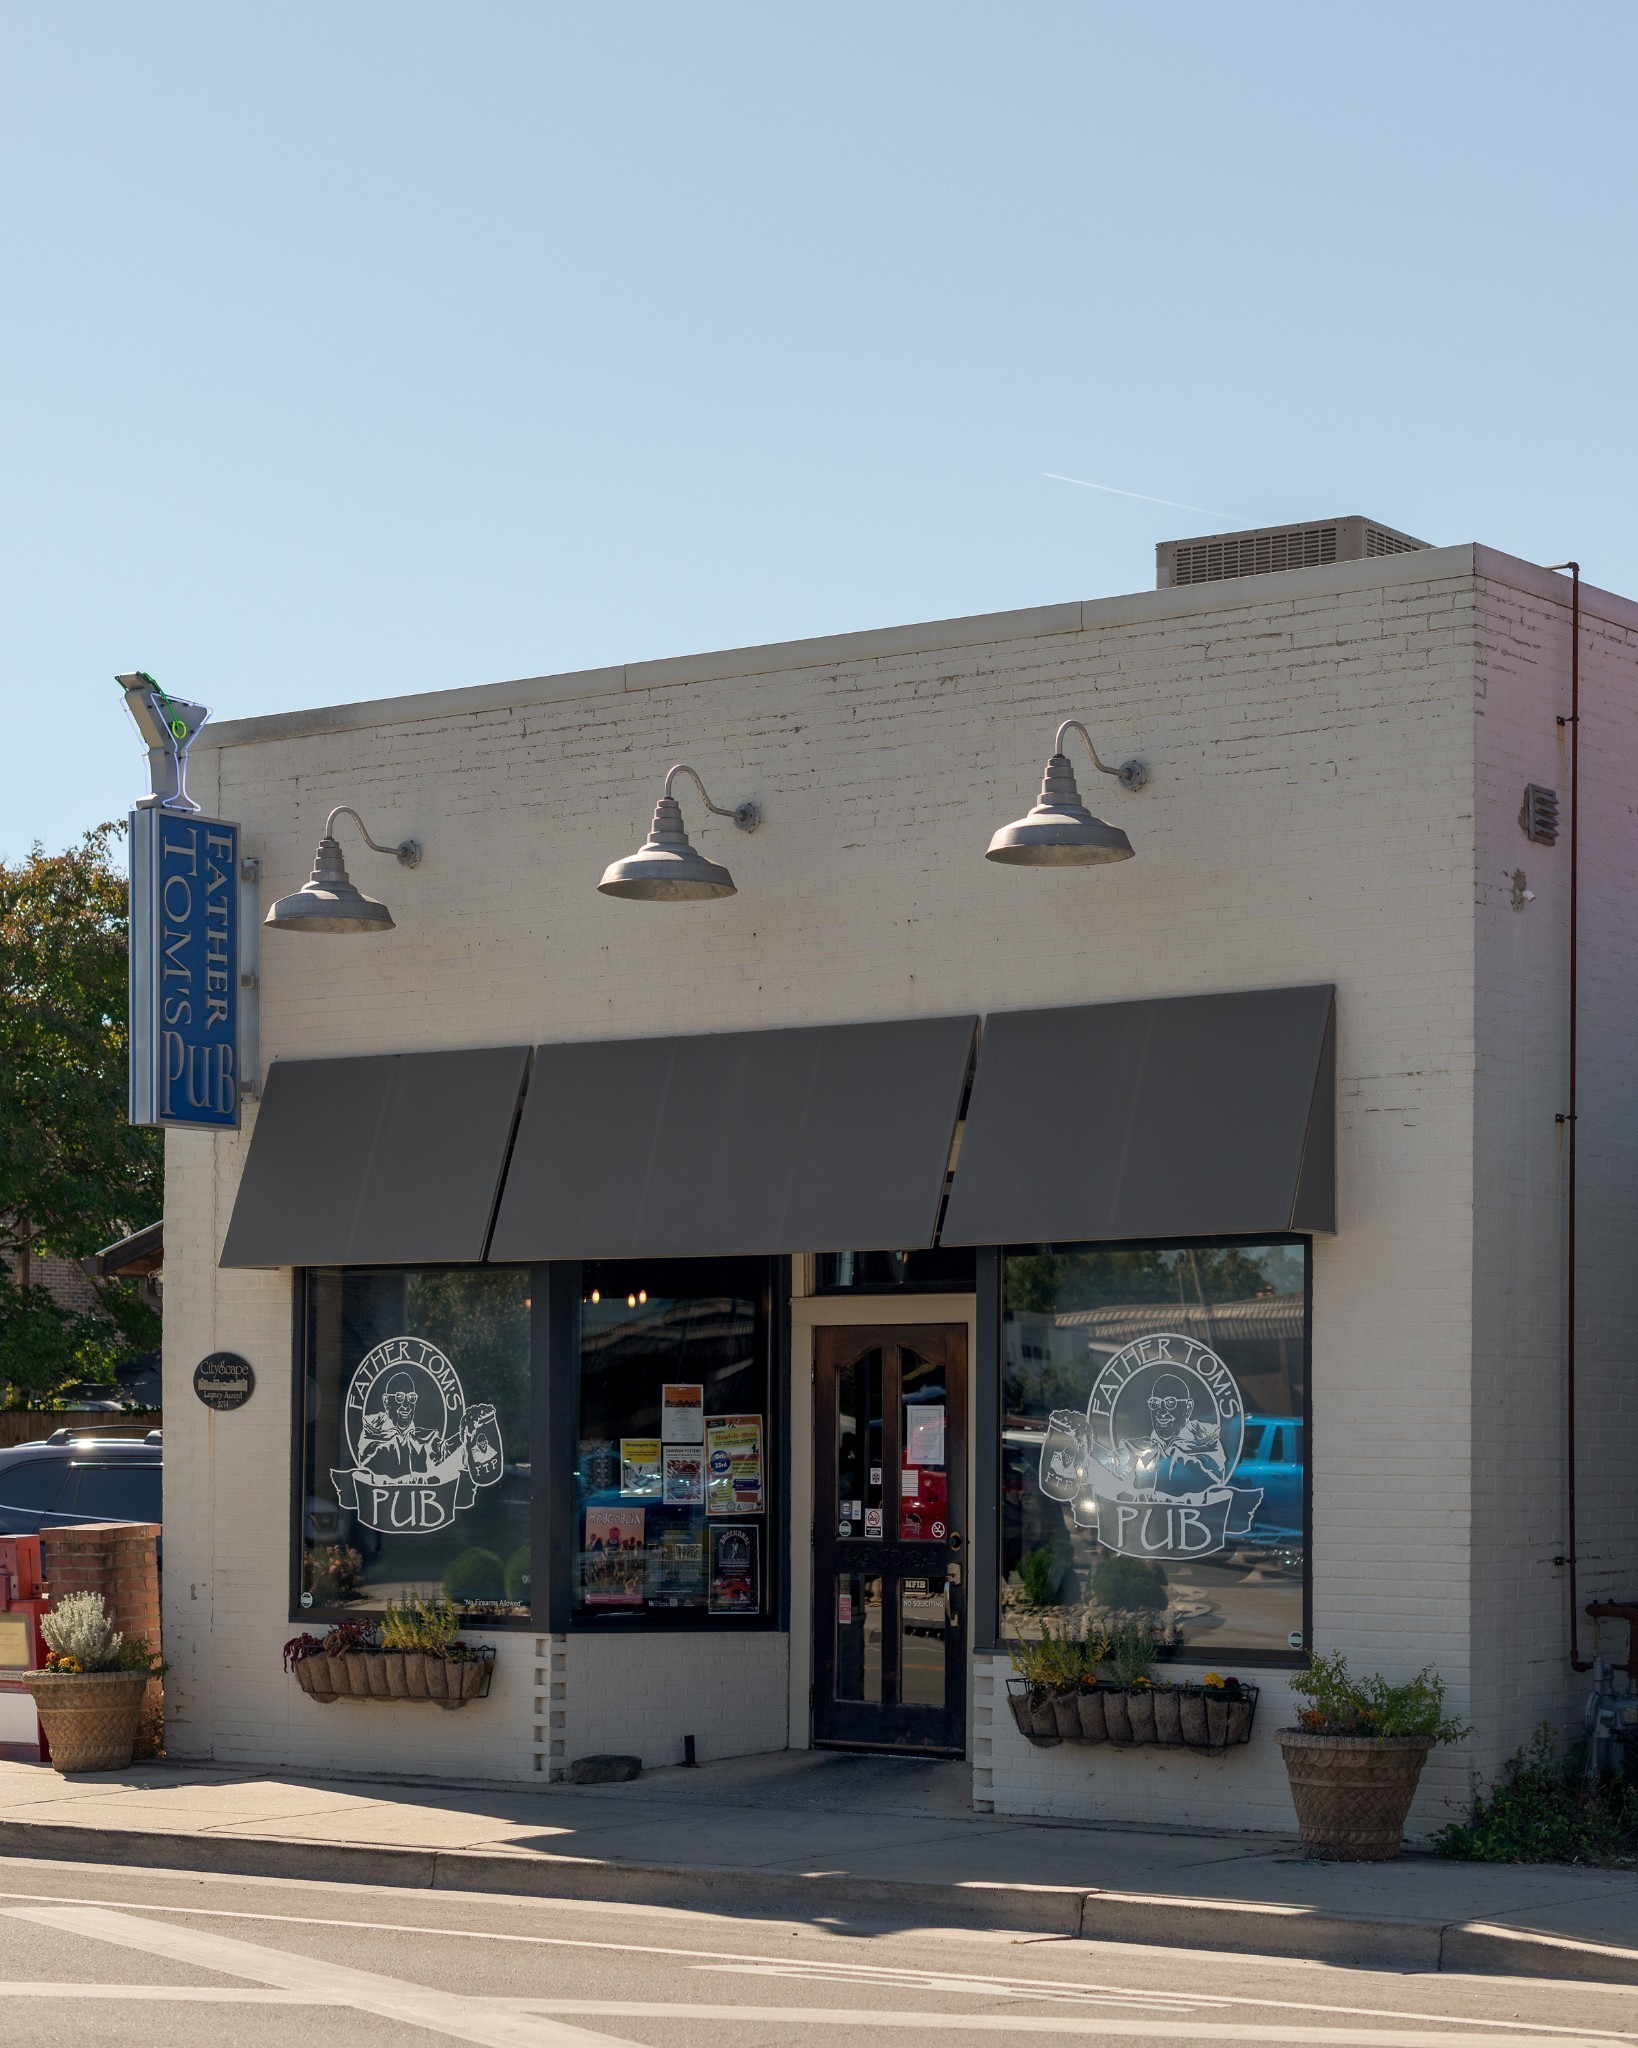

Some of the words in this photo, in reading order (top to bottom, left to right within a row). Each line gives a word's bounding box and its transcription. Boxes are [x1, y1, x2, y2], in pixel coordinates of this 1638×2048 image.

[164, 828, 198, 1025] TOM'S
[205, 829, 232, 1030] FATHER
[162, 1031, 236, 1115] PUB
[200, 1360, 249, 1379] CityScape
[349, 1341, 411, 1411] FATHER
[419, 1343, 462, 1411] TOM'S
[1092, 1339, 1173, 1417] FATHER
[1183, 1340, 1241, 1419] TOM'S
[203, 1391, 223, 1400] Legacy
[475, 1458, 498, 1477] FTP
[1044, 1471, 1074, 1490] FTP
[372, 1488, 445, 1527] PUB
[1117, 1506, 1212, 1551] PUB
[905, 1580, 926, 1588] NFIB
[474, 1598, 498, 1606] Firearms
[912, 1600, 944, 1608] SOLICITING
